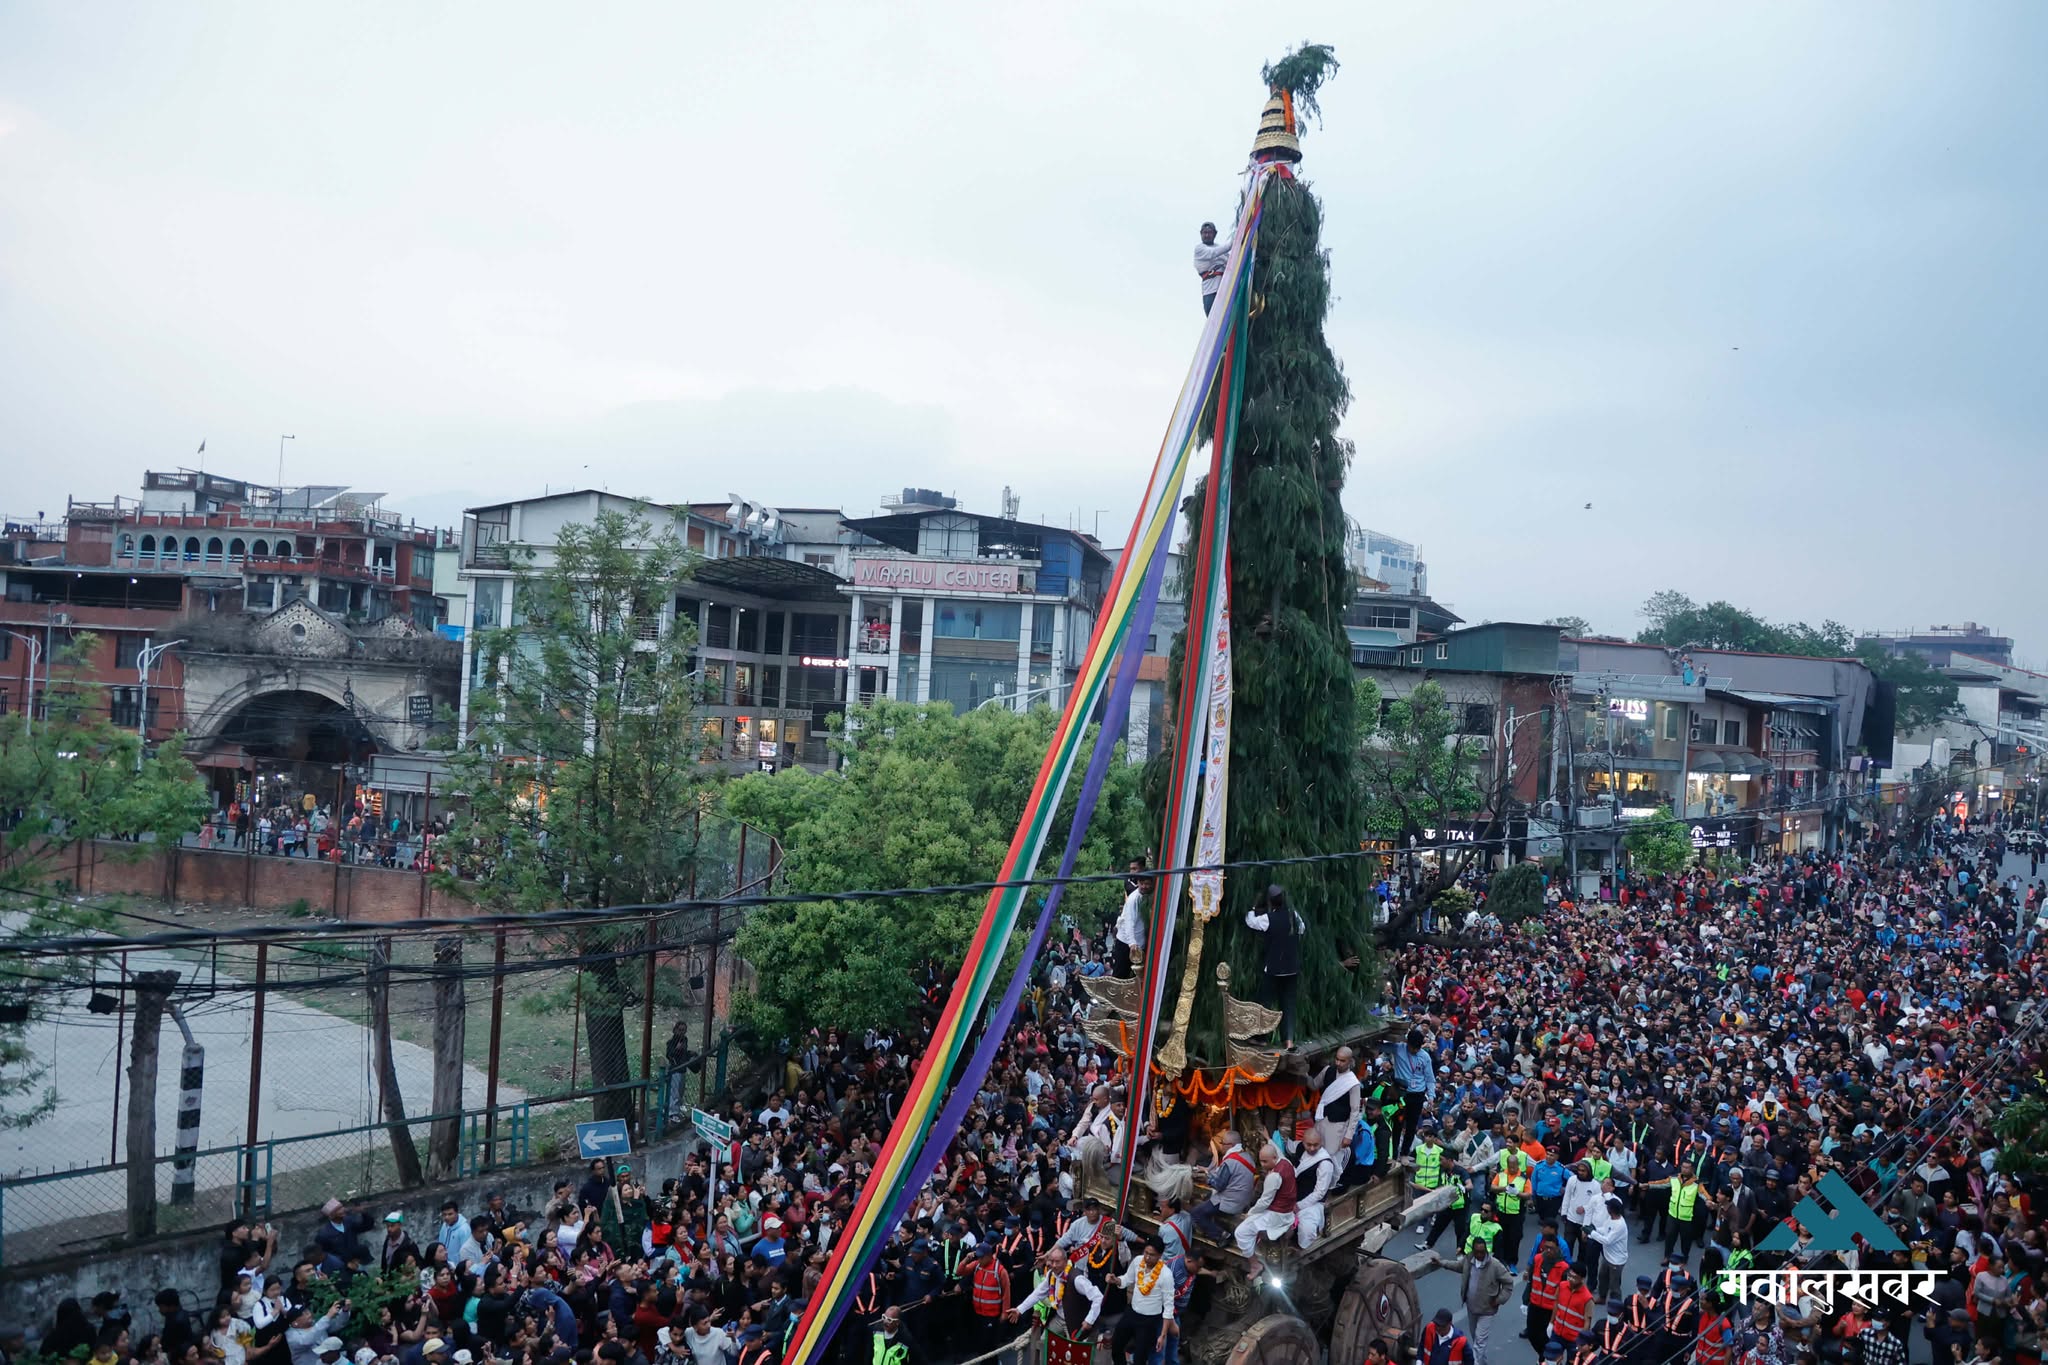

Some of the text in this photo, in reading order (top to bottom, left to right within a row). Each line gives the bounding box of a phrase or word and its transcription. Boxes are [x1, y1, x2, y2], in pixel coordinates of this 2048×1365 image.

[861, 565, 1012, 589] MAYALU CENTER
[1610, 698, 1648, 714] BLISS
